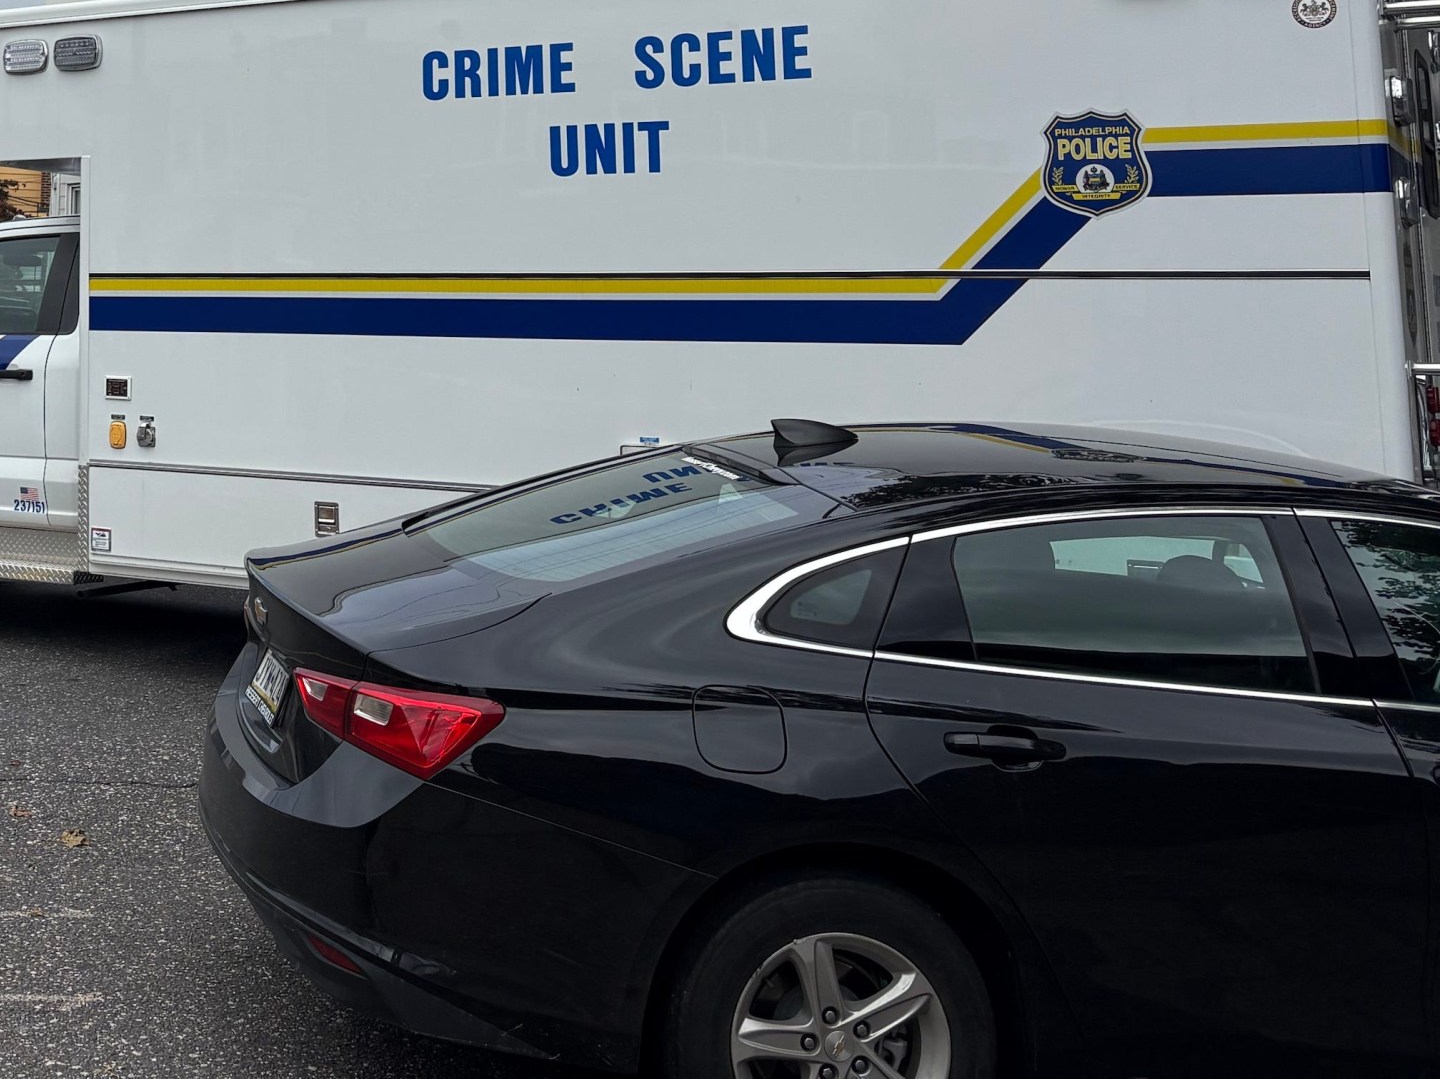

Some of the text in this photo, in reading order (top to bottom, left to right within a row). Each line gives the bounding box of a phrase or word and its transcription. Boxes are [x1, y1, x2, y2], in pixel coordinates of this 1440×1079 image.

[422, 25, 812, 101] CRIME SCENE
[1055, 126, 1131, 136] PHILADELPHIA
[549, 121, 670, 177] UNIT
[1057, 137, 1132, 161] POLICE
[13, 499, 45, 513] 237151
